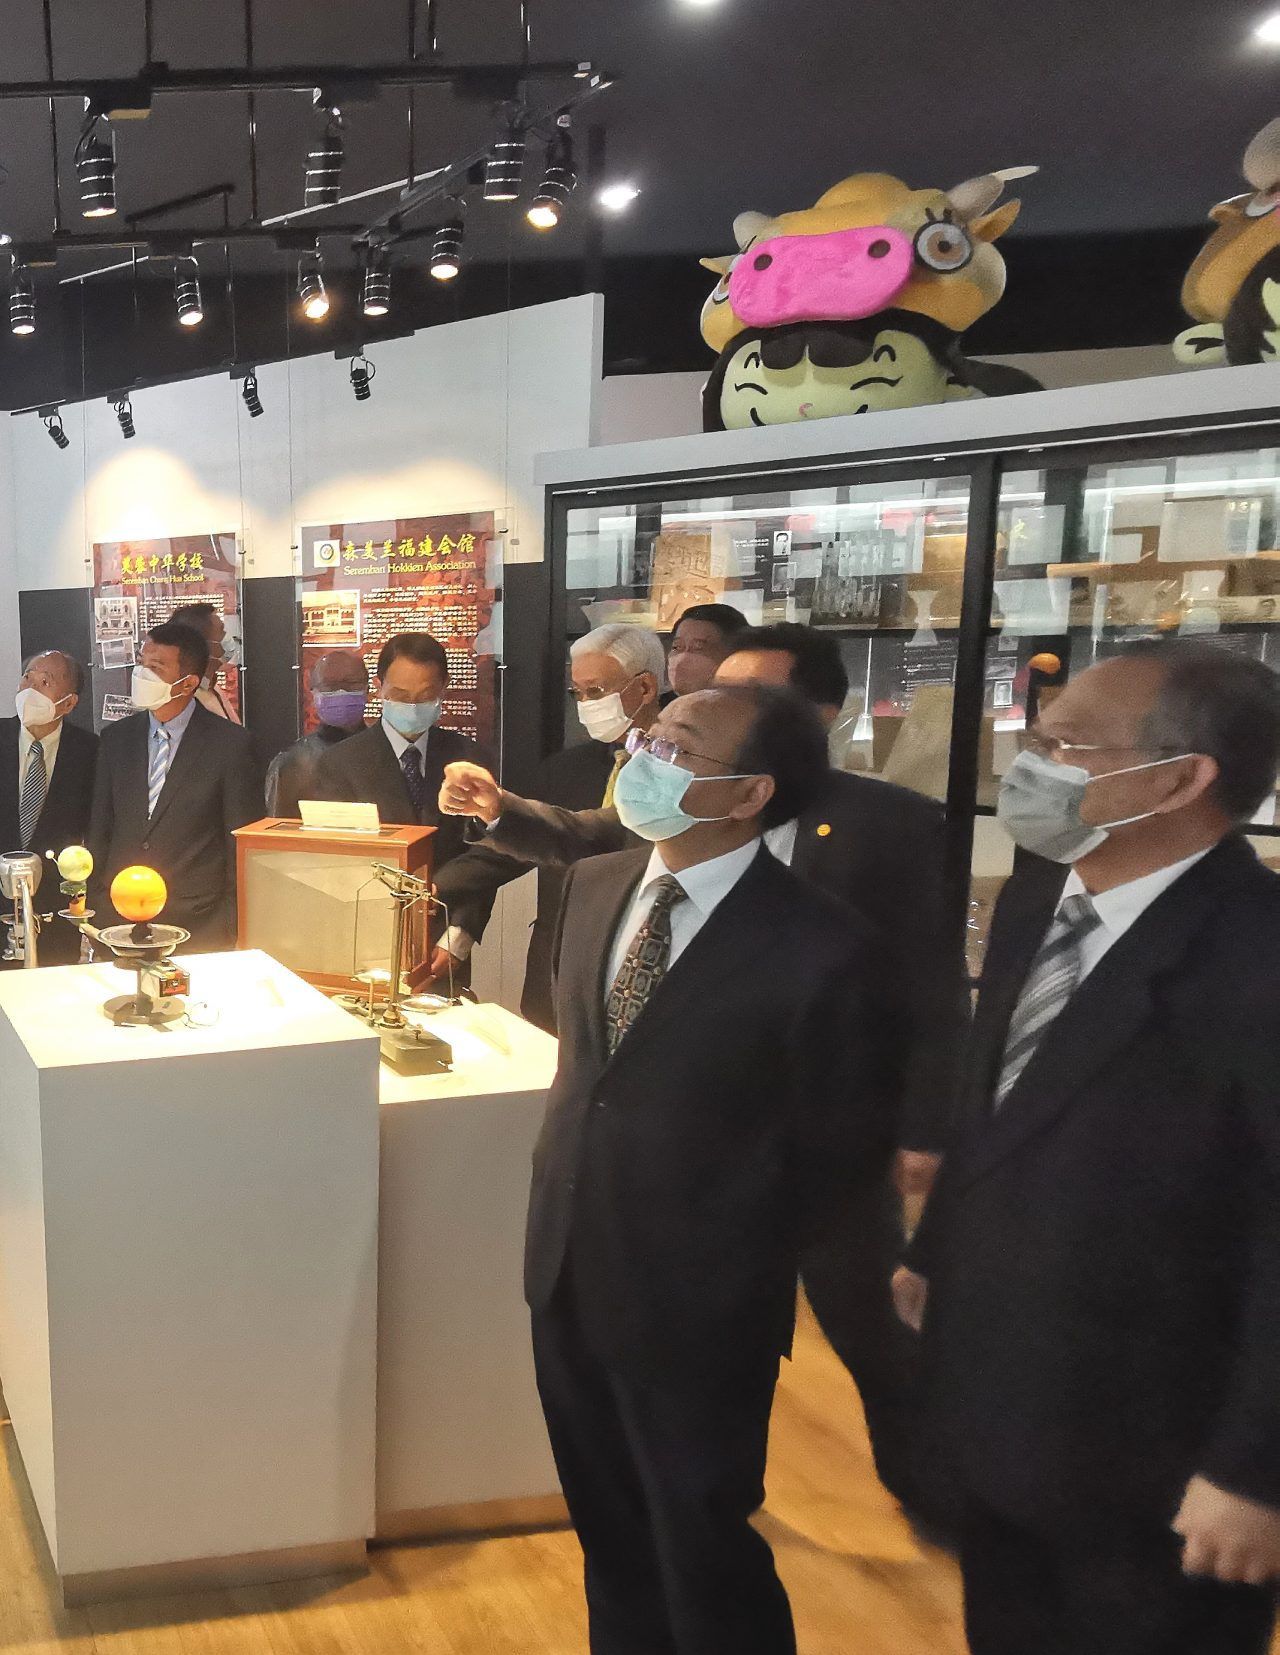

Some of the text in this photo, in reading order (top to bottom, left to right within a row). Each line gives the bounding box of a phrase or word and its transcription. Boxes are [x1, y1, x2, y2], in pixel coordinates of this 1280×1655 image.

[342, 533, 476, 561] 森美兰福建会馆
[343, 560, 477, 576] Seremban Hokkien Association
[121, 573, 205, 585] Seremban Chung Hua School
